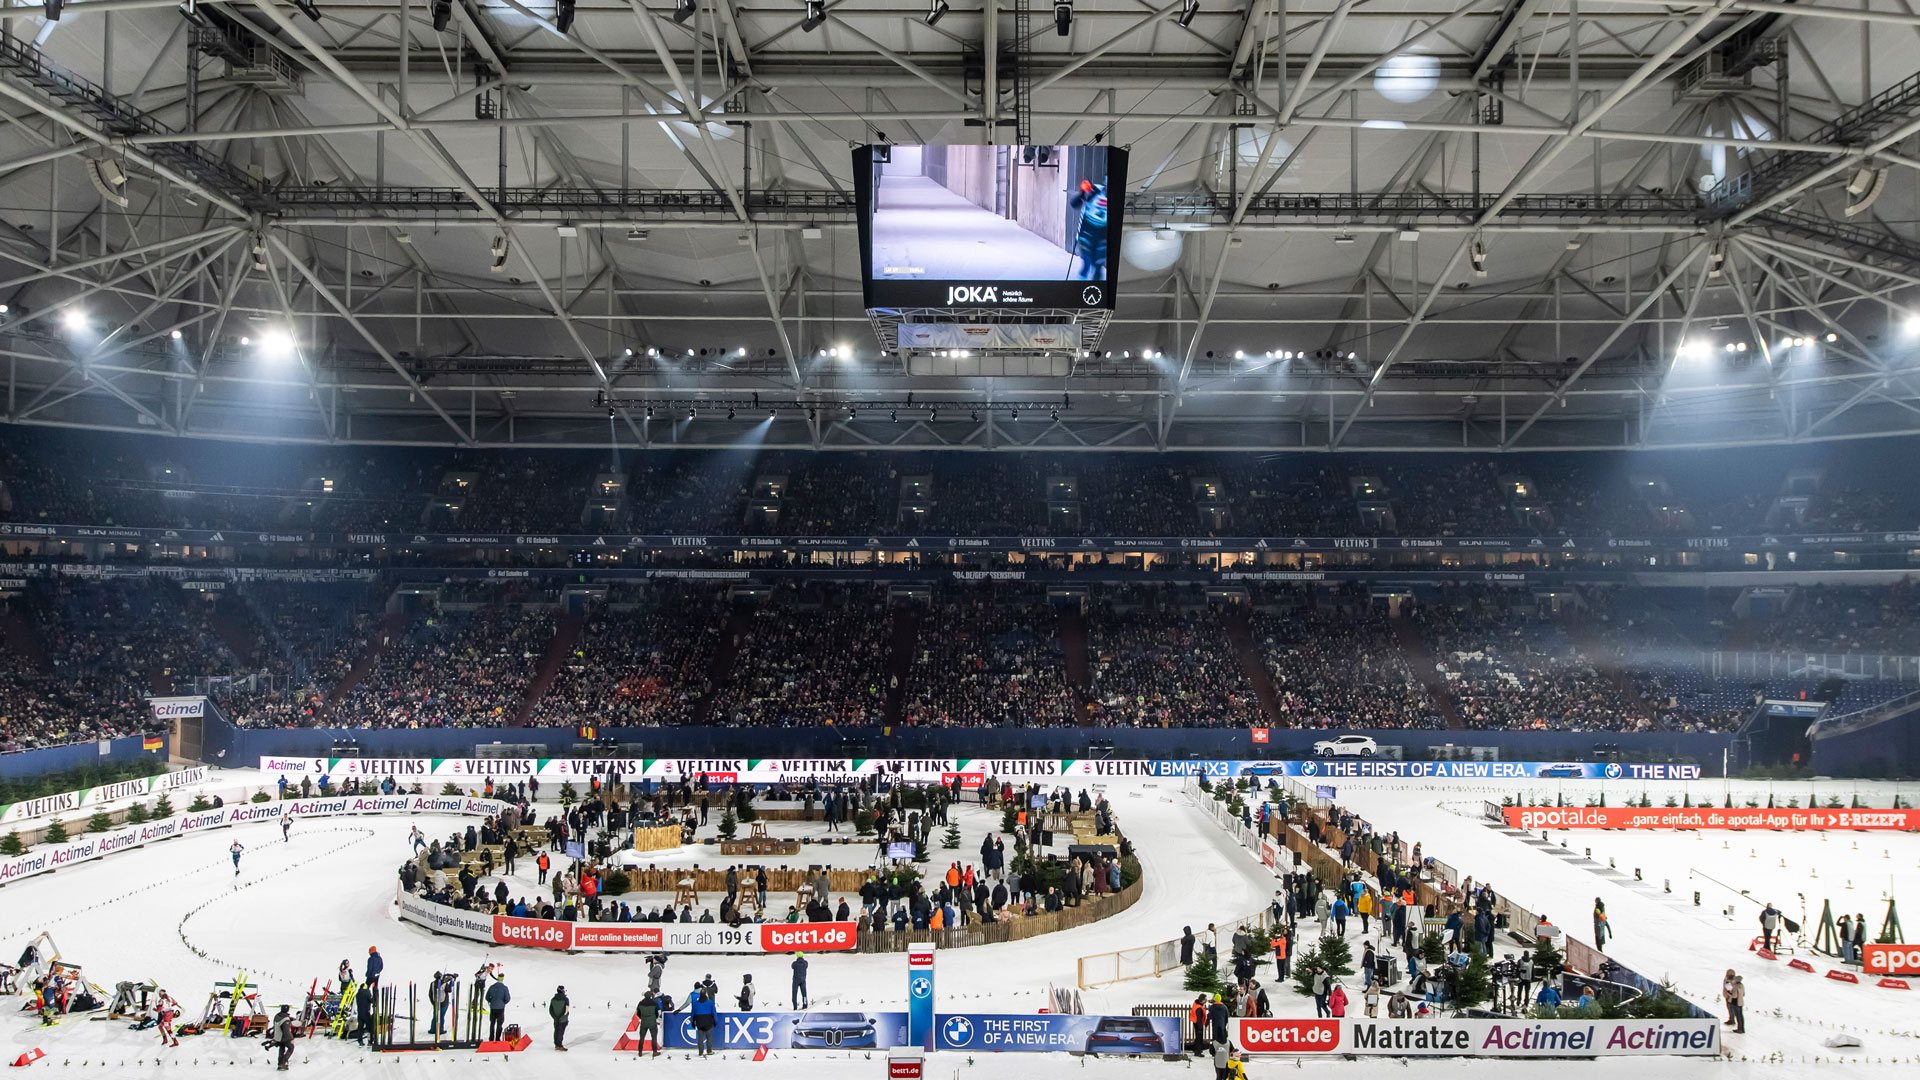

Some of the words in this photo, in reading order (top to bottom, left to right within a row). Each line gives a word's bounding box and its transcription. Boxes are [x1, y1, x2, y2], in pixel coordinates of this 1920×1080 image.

[947, 286, 998, 305] JOKA
[350, 534, 386, 544] VELTINS
[671, 537, 707, 546] VELTINS
[1021, 538, 1056, 547] VELTINS
[1334, 539, 1369, 548] VELTINS
[267, 759, 307, 772] Actimel
[361, 759, 425, 775] VELTINS
[466, 760, 531, 775] VELTINS
[990, 760, 1055, 775] VELTINS
[1095, 761, 1151, 776] VELTIN
[1160, 762, 1201, 776] BMW
[1324, 762, 1358, 776] THE
[1361, 762, 1408, 776] FIRST
[1411, 762, 1433, 776] OF
[1435, 763, 1448, 776] A
[1451, 763, 1490, 777] NEW
[1493, 763, 1531, 777] ERA.
[1630, 765, 1665, 779] THE
[169, 768, 203, 787] VELTINS
[697, 775, 735, 783] tt1.de
[884, 774, 905, 784] Ziel
[944, 775, 982, 784] be1.de
[103, 780, 143, 801] VELTINS
[26, 793, 72, 817] VELTINS
[289, 799, 348, 815] Actimel
[353, 798, 409, 811] Actimel
[414, 798, 462, 811] Actimel
[466, 799, 500, 815] Actimel
[180, 810, 225, 831] Actimel
[230, 804, 284, 822] Actimel
[1520, 809, 1608, 827] apotal.de
[1661, 813, 1705, 826] einfach,
[1707, 813, 1725, 825] die
[1727, 813, 1789, 828] apotal-App
[1791, 813, 1809, 825] für
[1811, 813, 1826, 825] Ihr
[1839, 813, 1907, 827] E-REZEPT
[140, 819, 176, 842] Actimel
[98, 830, 137, 853] Actimel
[51, 840, 96, 866] Actimel
[0, 853, 47, 880] Actimel
[465, 919, 493, 934] Matratze
[502, 922, 564, 943] bett1.de
[579, 934, 598, 942] Jetzt
[600, 933, 622, 942] online
[624, 934, 659, 943] bestellen!
[670, 934, 692, 945] nur
[696, 931, 712, 945] ab
[718, 931, 742, 945] 199
[744, 931, 753, 945] €
[771, 928, 847, 945] bett1.de
[724, 1016, 775, 1045] iX3
[984, 1020, 1011, 1032] THE
[1013, 1020, 1050, 1032] FIRST
[984, 1033, 1002, 1044] OF
[1004, 1033, 1014, 1044] A
[1017, 1033, 1047, 1044] NEW
[1050, 1033, 1080, 1045] ERA.
[1246, 1026, 1332, 1044] bett1.de
[1353, 1023, 1470, 1050] Matratze
[1482, 1025, 1595, 1050] Actimel
[1606, 1024, 1717, 1050] Actimel
[892, 1067, 919, 1075] bett1.de
